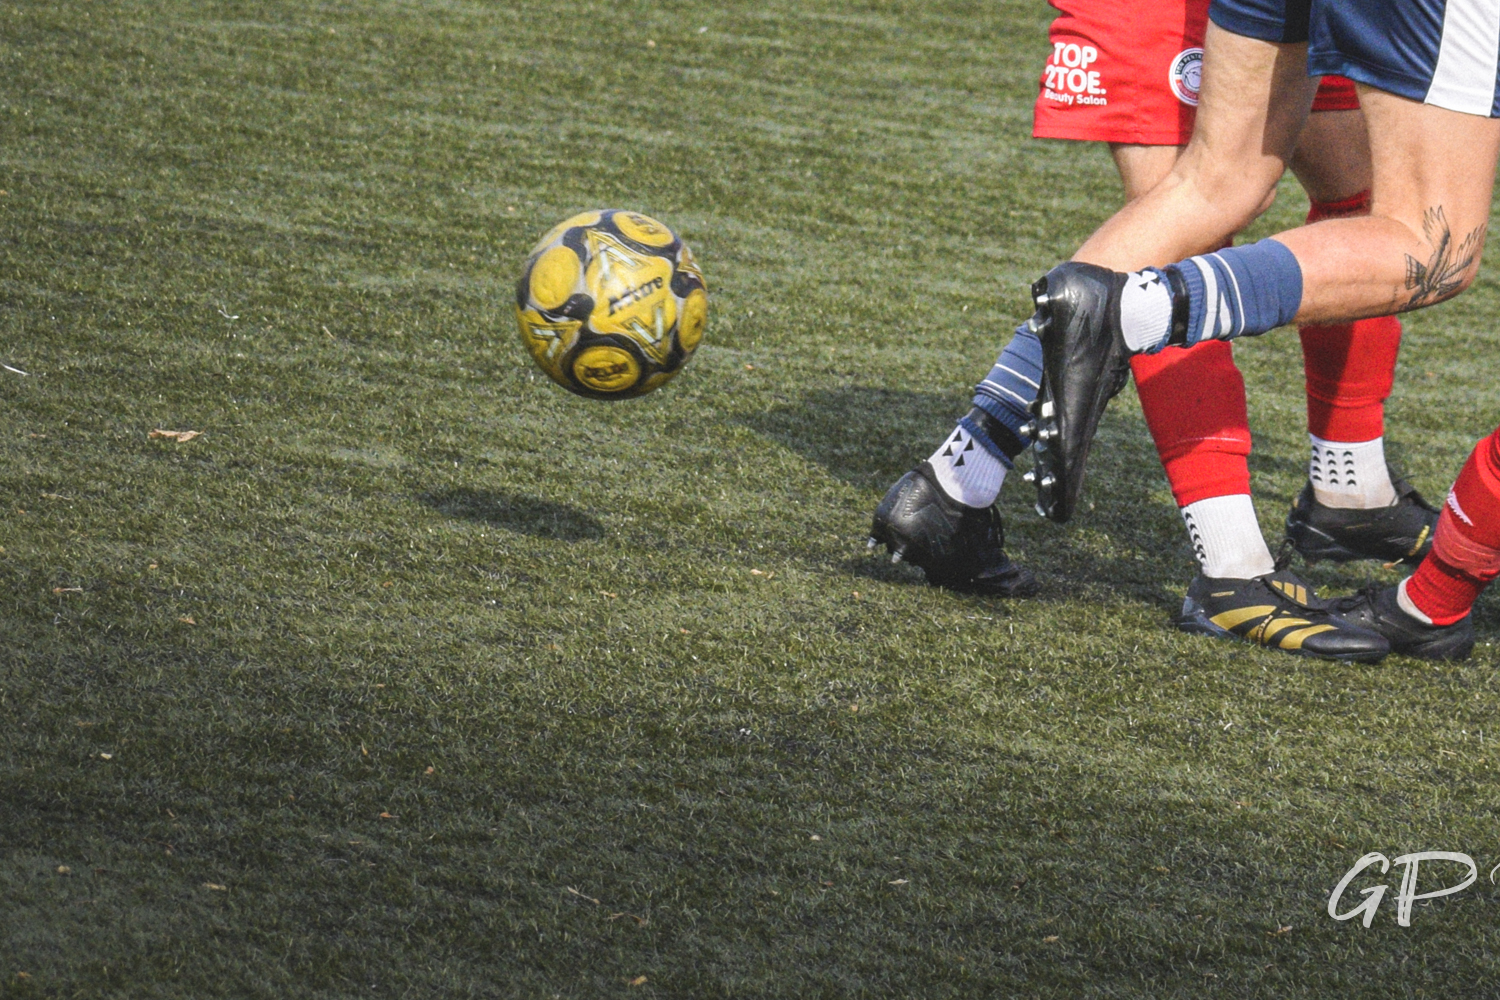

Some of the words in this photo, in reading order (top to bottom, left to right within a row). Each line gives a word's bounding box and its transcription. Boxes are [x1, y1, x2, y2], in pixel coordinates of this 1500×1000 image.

[1053, 42, 1097, 69] TOP
[1045, 64, 1107, 94] 2TOE.
[1045, 89, 1074, 105] Beauty
[1076, 94, 1107, 105] Salon
